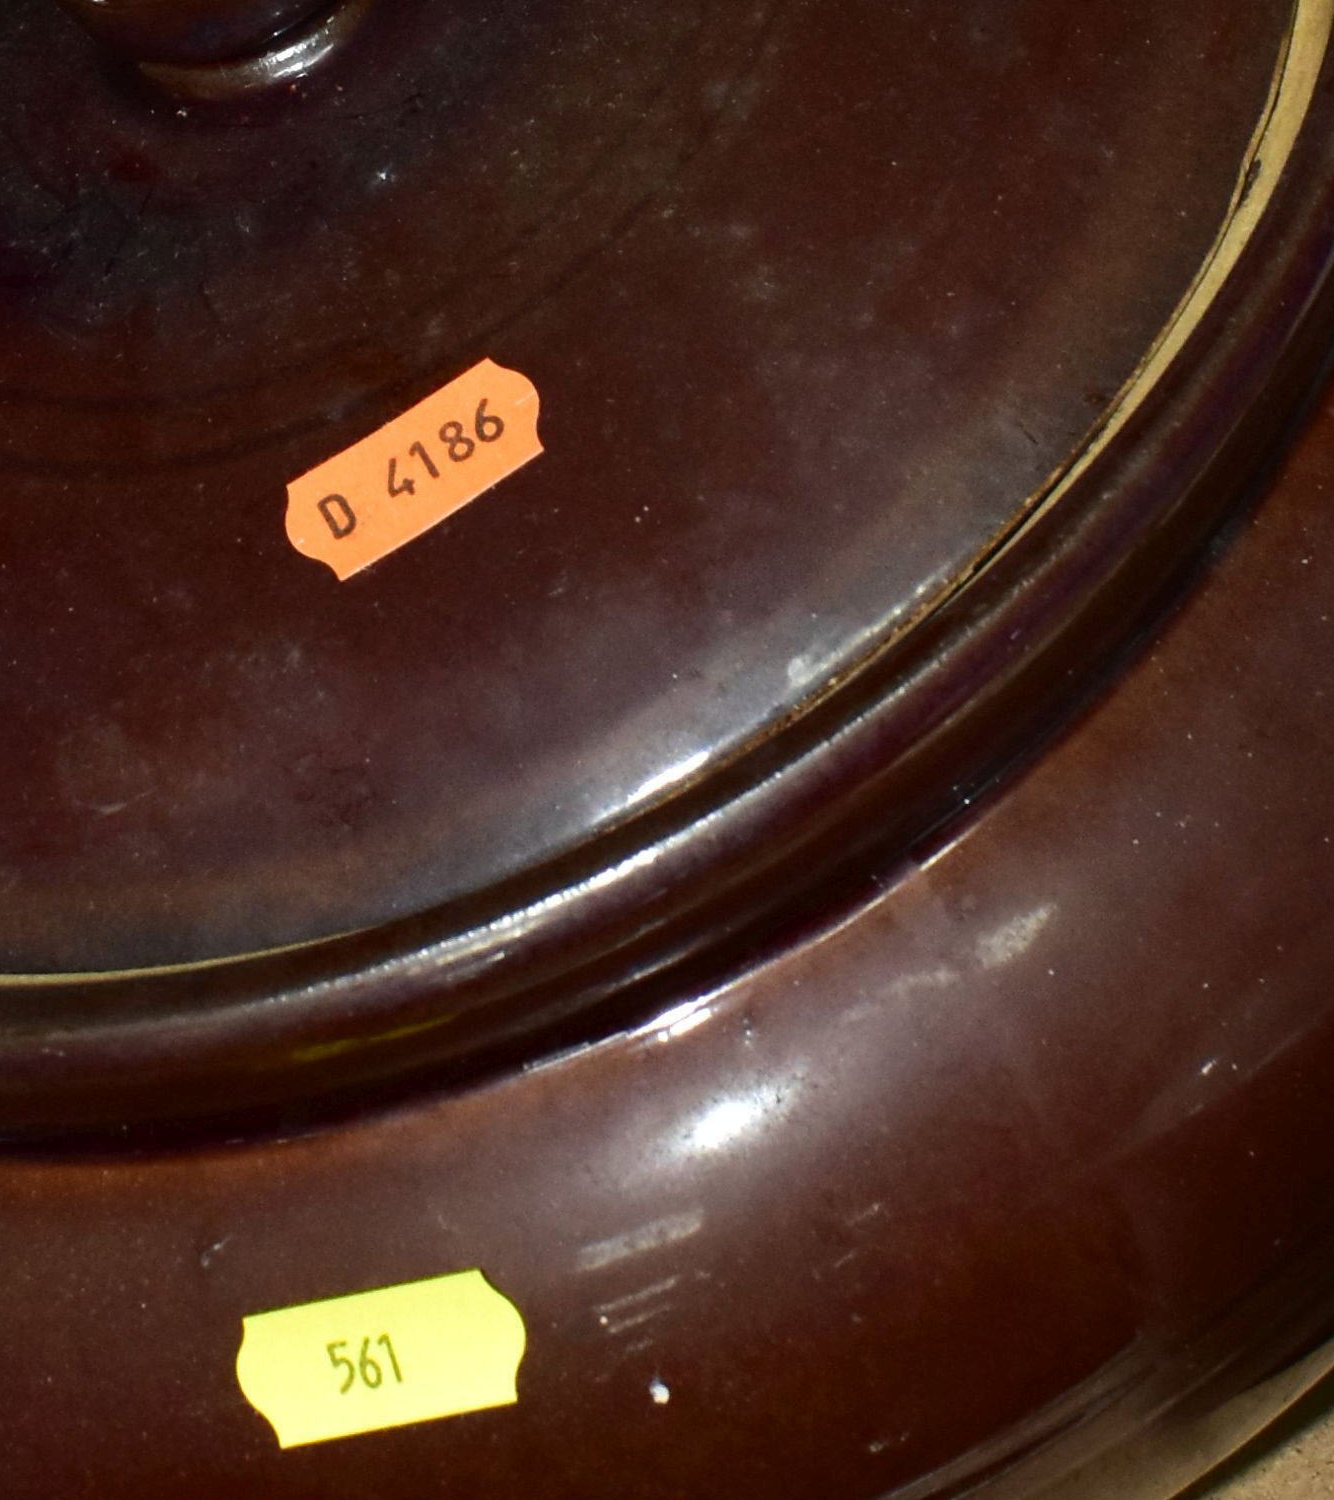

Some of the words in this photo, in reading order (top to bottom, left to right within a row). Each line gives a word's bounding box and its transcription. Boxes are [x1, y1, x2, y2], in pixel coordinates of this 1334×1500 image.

[317, 494, 356, 539] D
[388, 398, 504, 497] 4186
[327, 1332, 403, 1394] 561
